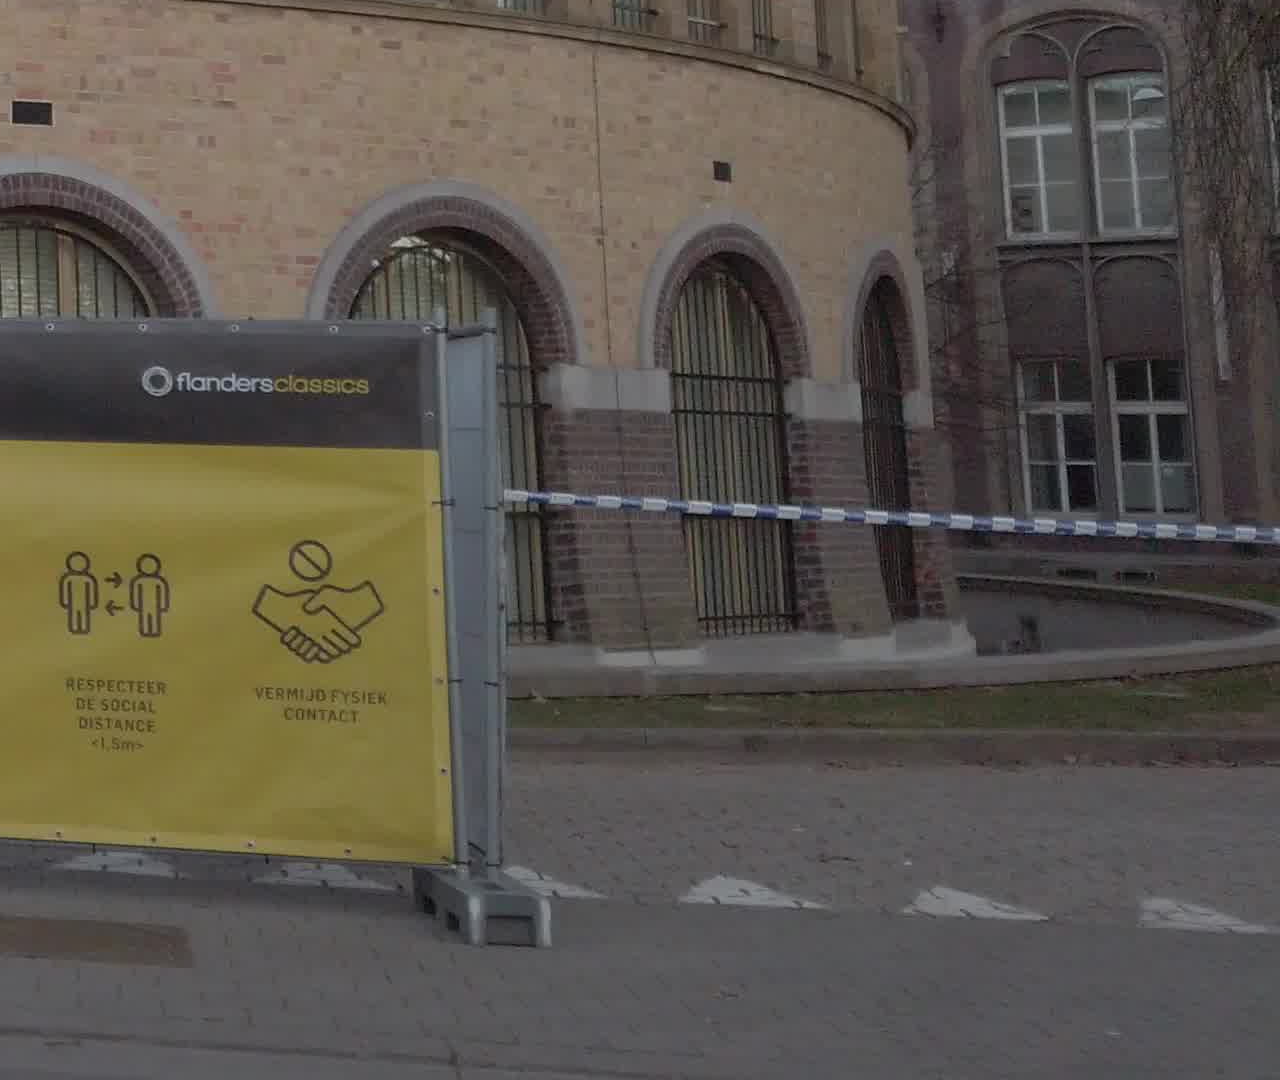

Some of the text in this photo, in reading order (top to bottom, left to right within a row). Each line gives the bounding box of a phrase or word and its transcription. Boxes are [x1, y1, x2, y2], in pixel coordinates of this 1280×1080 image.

[65, 677, 167, 695] RESPECTEER
[254, 687, 388, 706] VERMIJD FYSIEK
[76, 698, 157, 714] DE SOCIAL
[284, 707, 359, 724] CONTACT
[78, 717, 156, 734] DISTANCE
